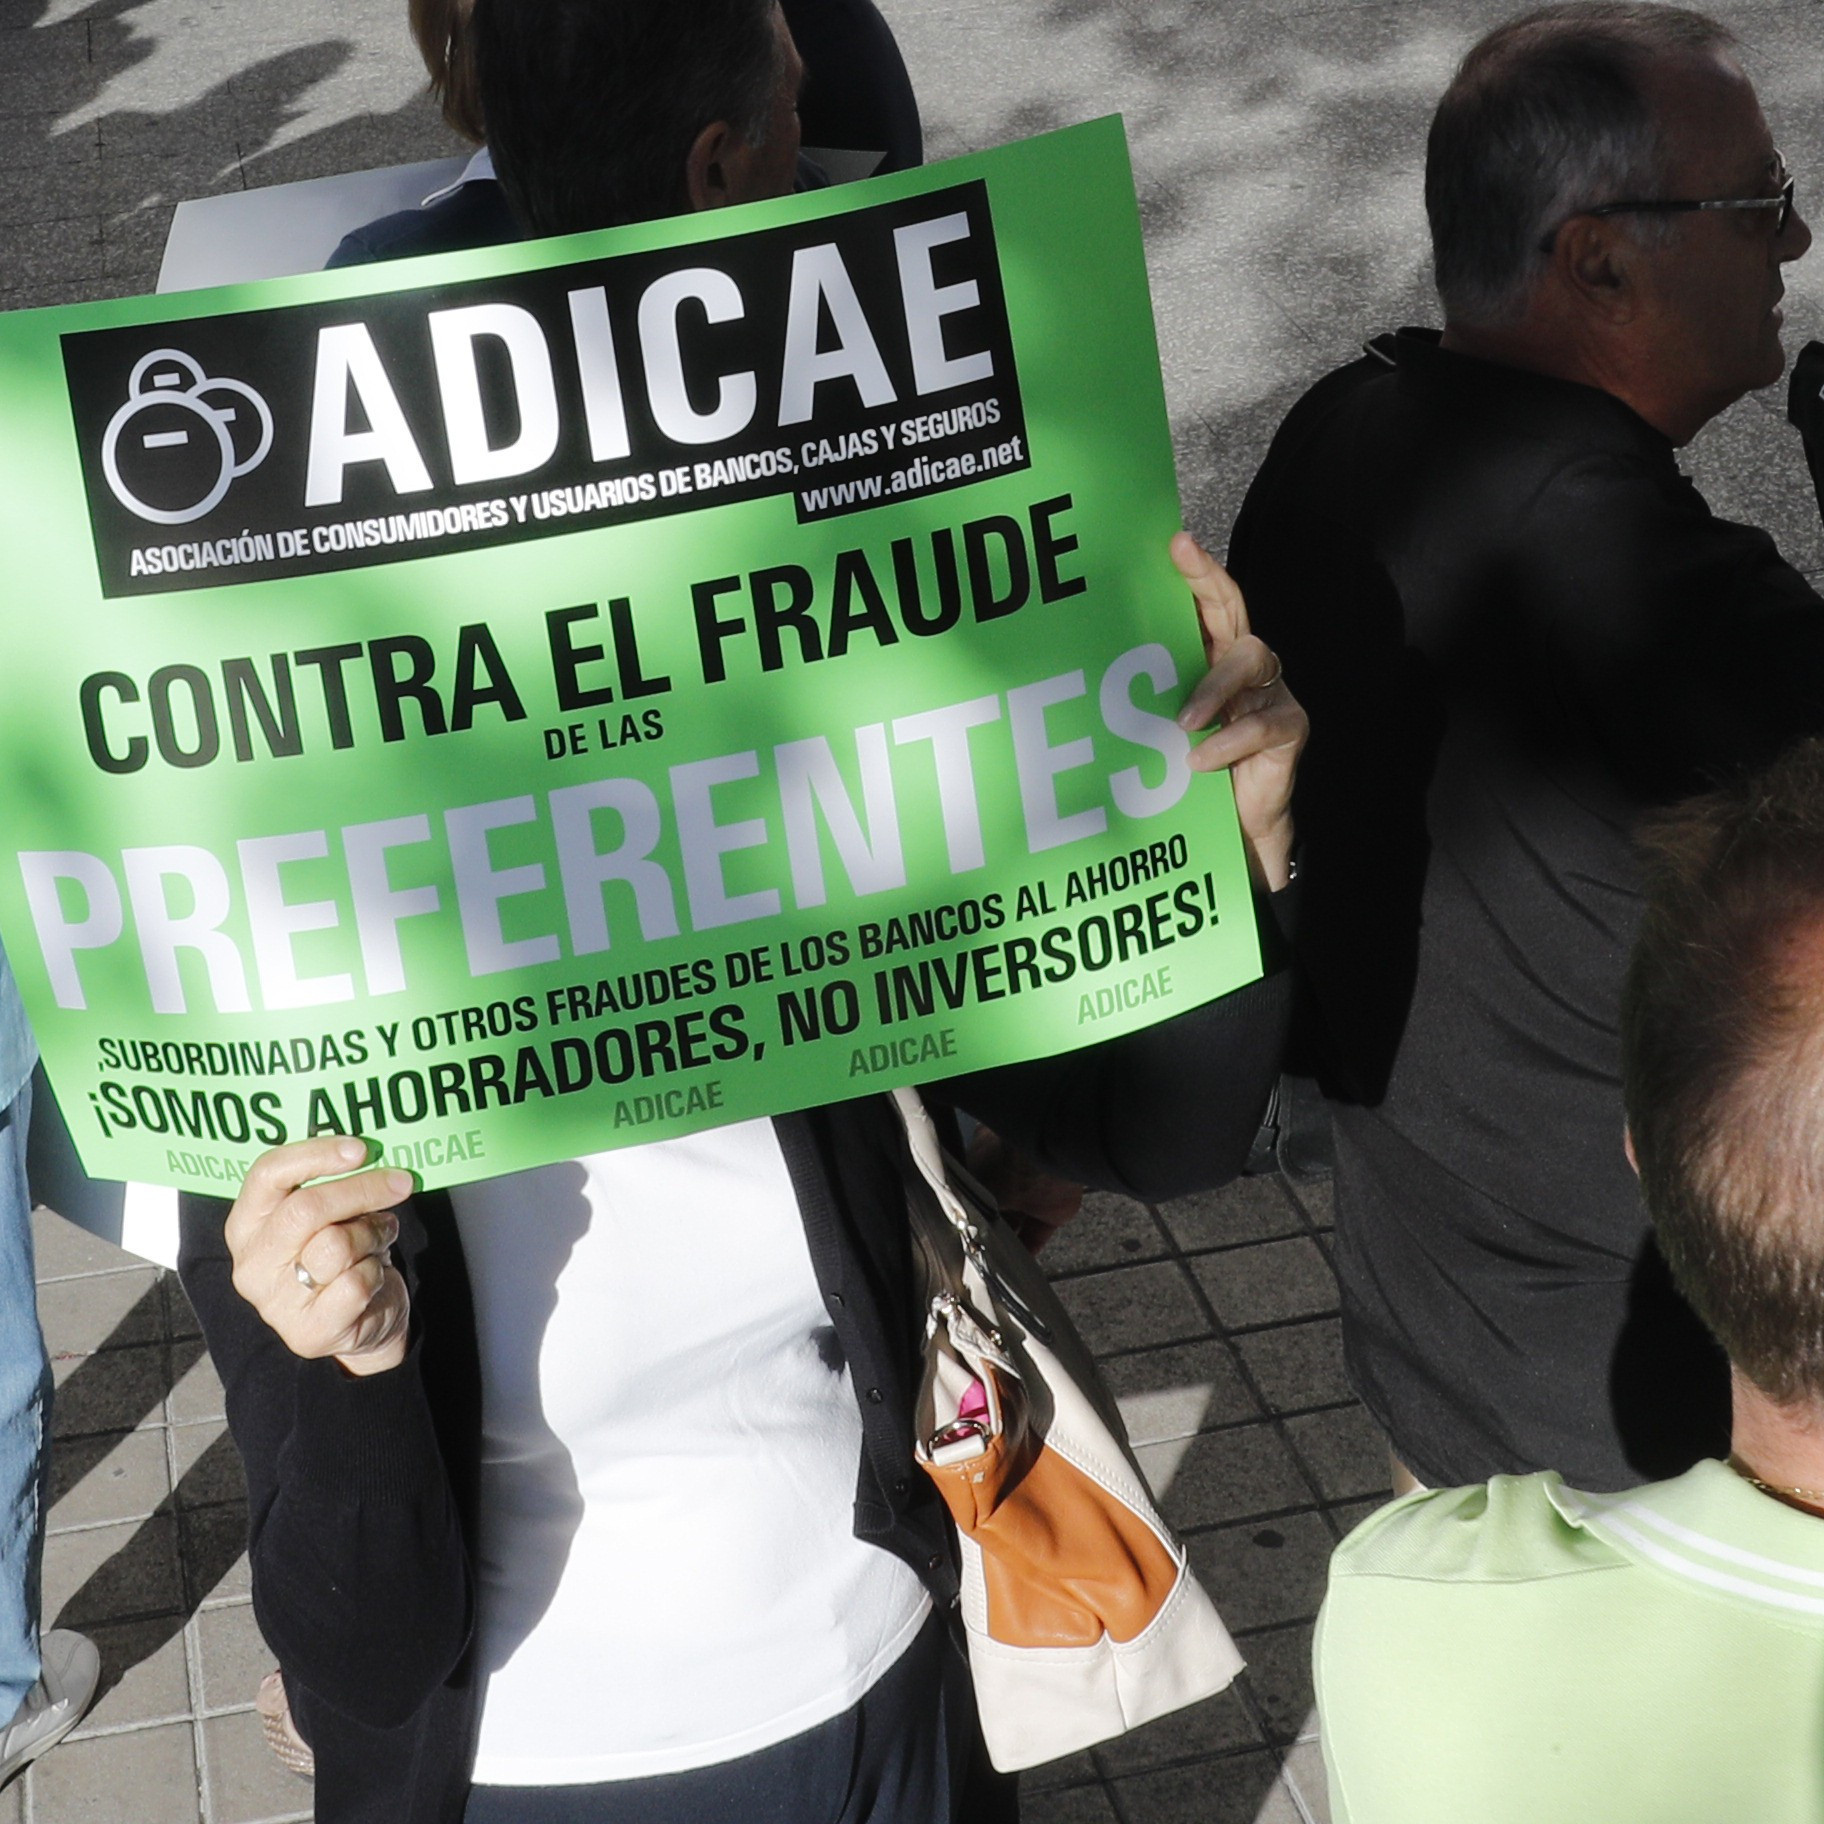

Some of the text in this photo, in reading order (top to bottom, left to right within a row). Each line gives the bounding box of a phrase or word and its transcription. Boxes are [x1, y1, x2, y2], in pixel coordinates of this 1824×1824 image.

[304, 211, 994, 507] ADICAE
[129, 399, 1001, 577] ASOCIACIÓN DE CONSUMIDORES Y USUARIOS DE BANCOS, CAJAS Y SEGUROS
[801, 435, 1024, 512] www.adicae.net
[79, 493, 1087, 775] CONTRA EL FRAUDE
[543, 709, 664, 760] DE LAS
[17, 642, 1192, 1015] PREFERENTES
[88, 872, 1221, 1147] ¡SOMOS AHORRADORES, NO INVERSORES!
[376, 1022, 401, 1057] Y
[412, 995, 539, 1052] OTROS
[546, 962, 717, 1026] FRAUDES
[725, 946, 774, 989] DE
[781, 930, 850, 977] LOS
[859, 893, 1006, 961] BANCOS
[1015, 879, 1057, 922] AL
[1065, 832, 1189, 907] AHORRO
[379, 1128, 486, 1172] DICAE
[613, 1080, 725, 1128] ADICAE
[848, 1028, 958, 1077] ADICAE
[1076, 965, 1173, 1025] ADICAE
